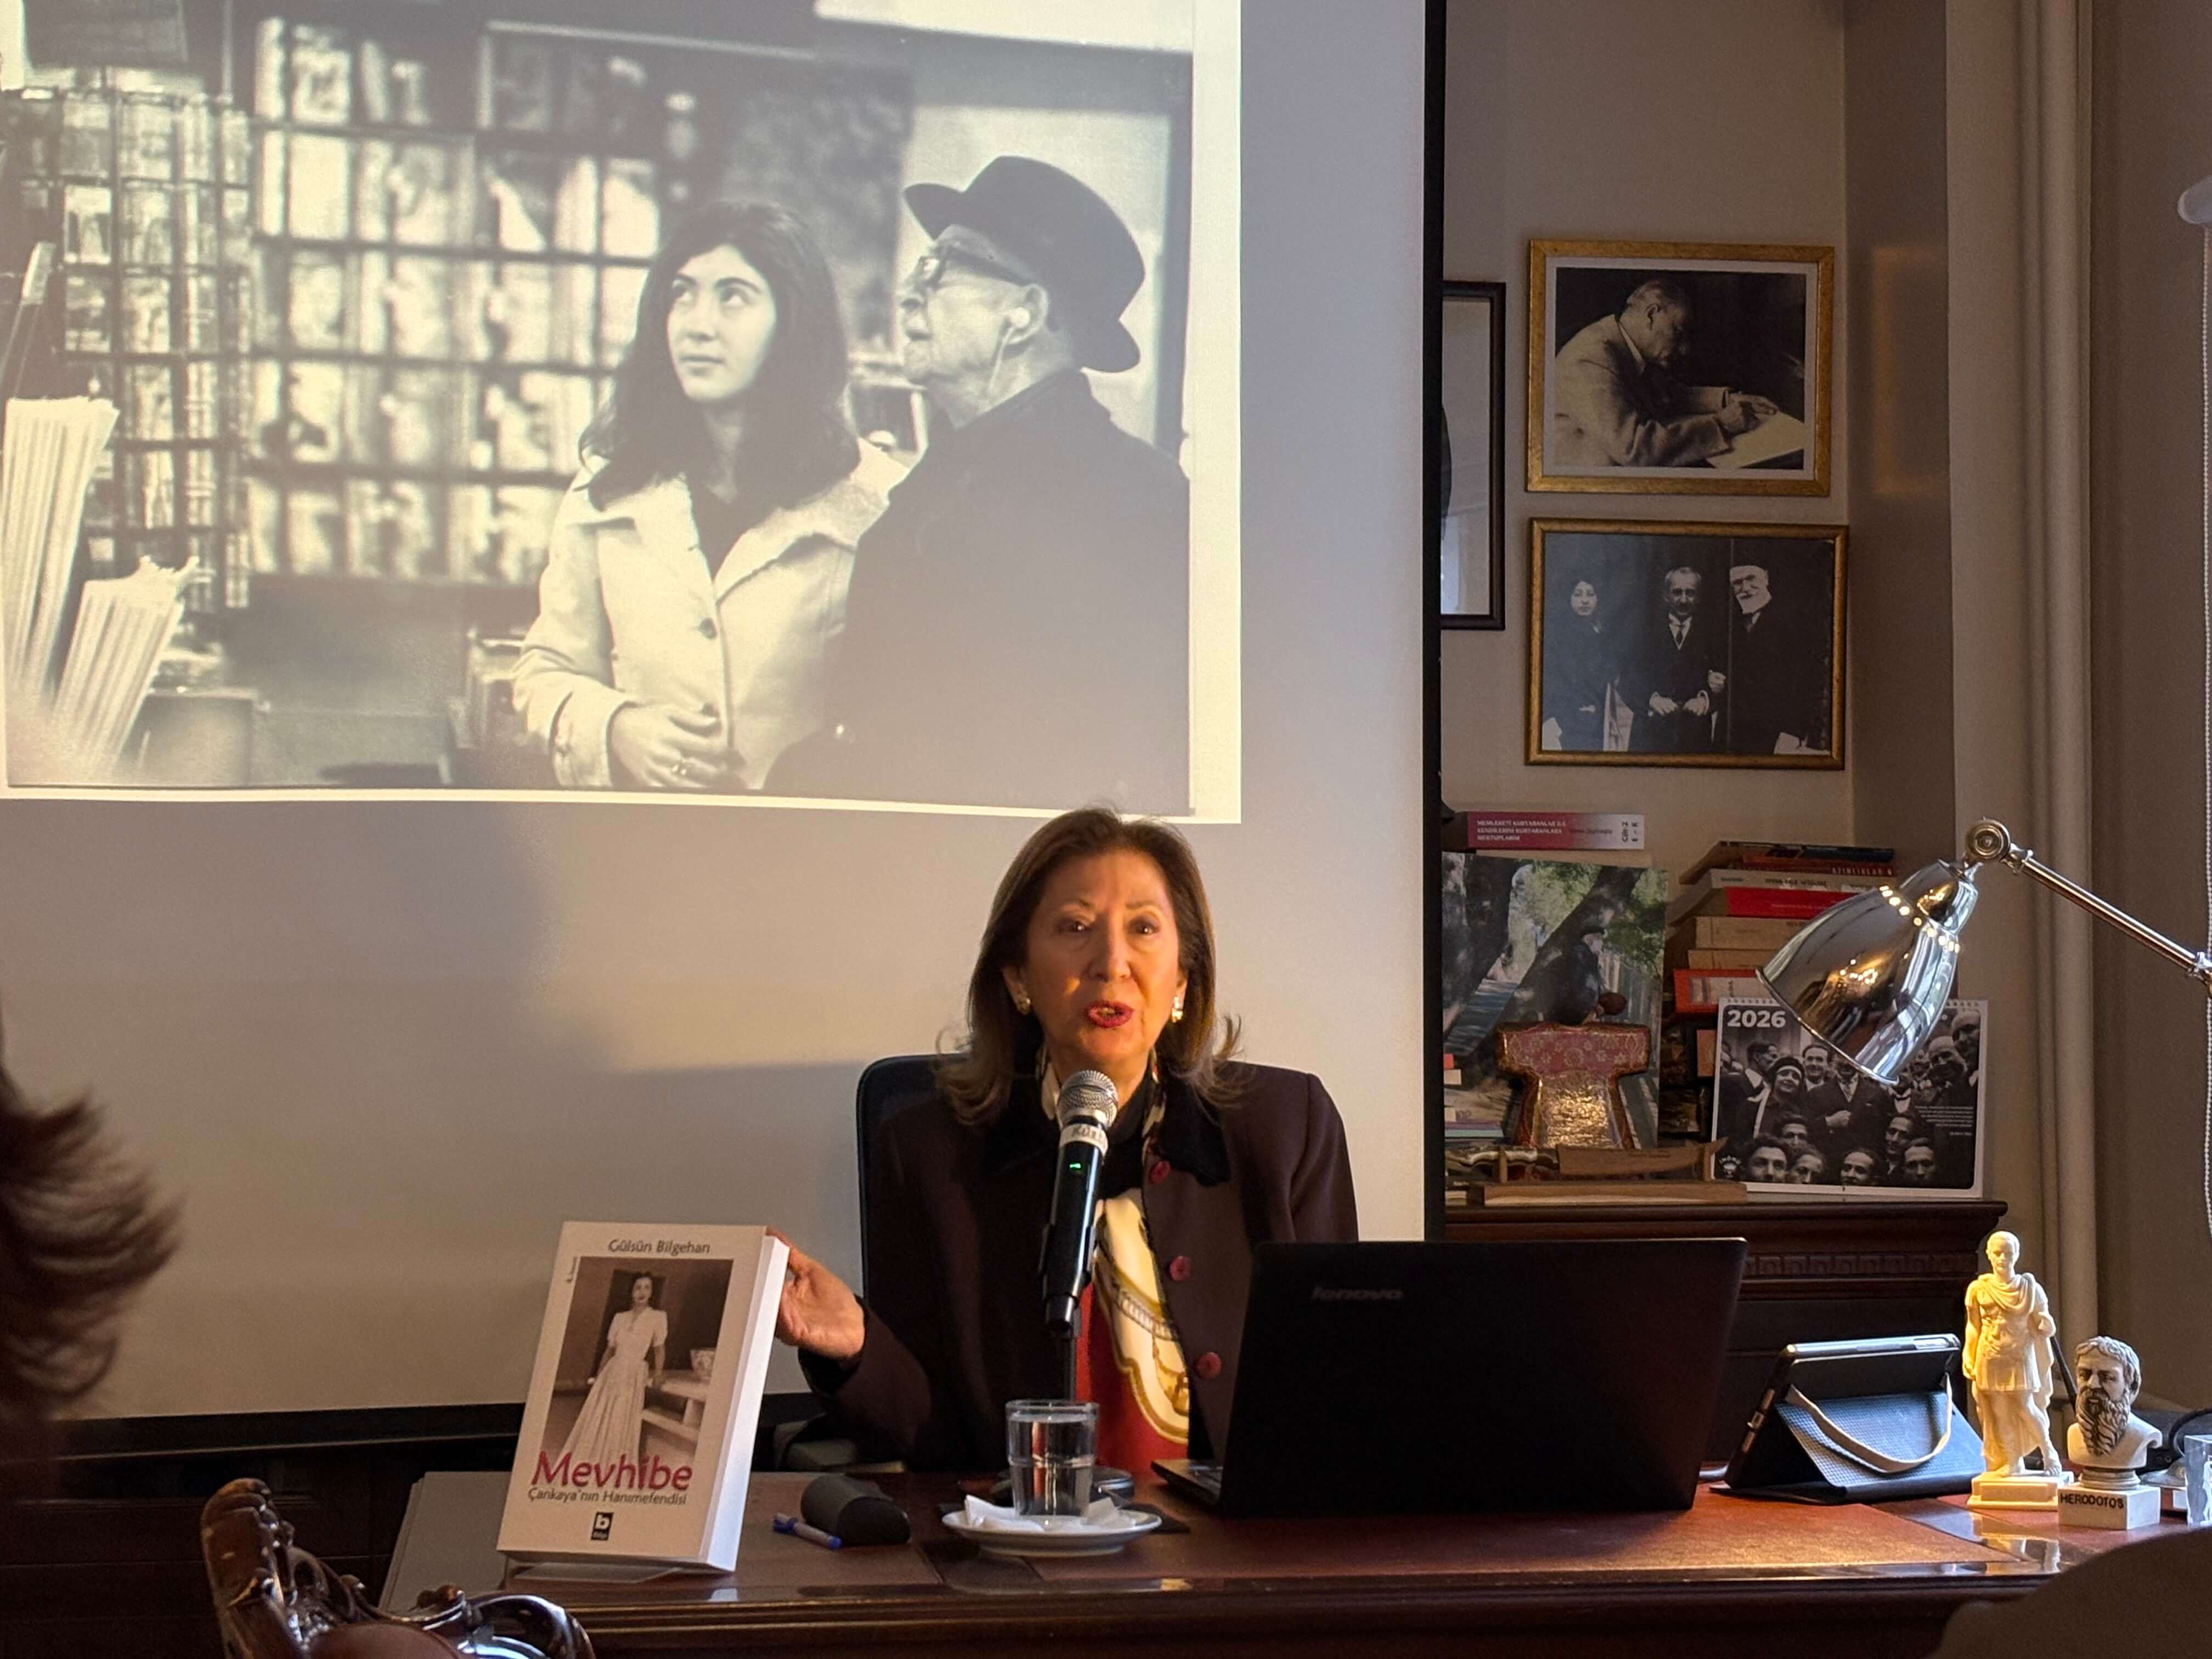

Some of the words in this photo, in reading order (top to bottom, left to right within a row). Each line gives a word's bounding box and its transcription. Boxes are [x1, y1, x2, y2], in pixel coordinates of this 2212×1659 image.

[1727, 1009, 1786, 1028] 2026
[608, 1239, 653, 1253] Gülsün
[656, 1240, 711, 1256] Bilgehan
[531, 1451, 693, 1491] Mevhibe
[528, 1487, 599, 1503] Çankaya'nın
[603, 1489, 687, 1505] Hanımefendisi
[2059, 1493, 2124, 1509] HERODOTOS
